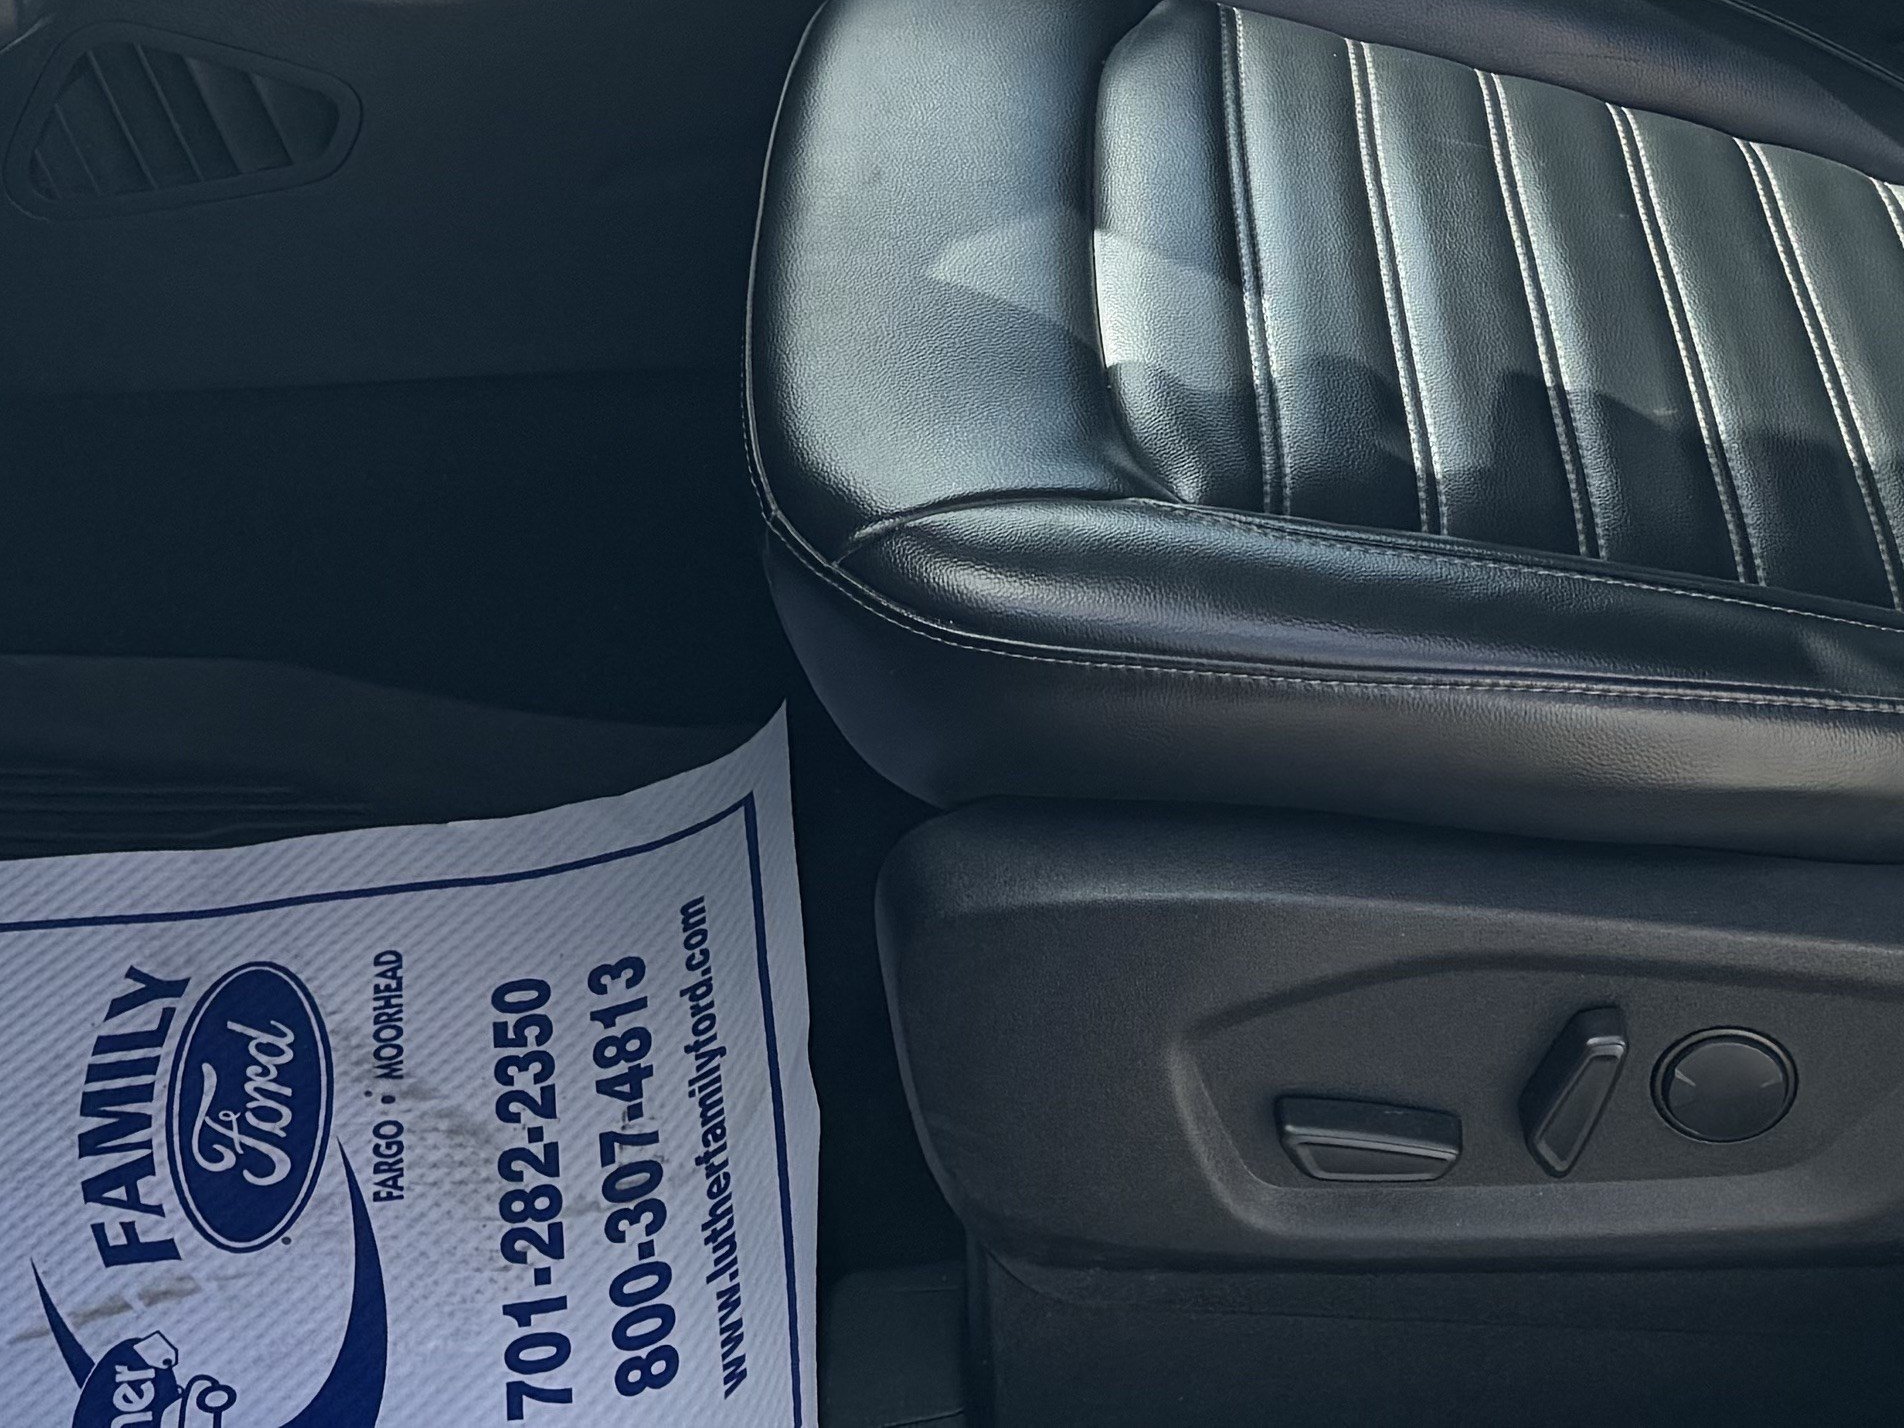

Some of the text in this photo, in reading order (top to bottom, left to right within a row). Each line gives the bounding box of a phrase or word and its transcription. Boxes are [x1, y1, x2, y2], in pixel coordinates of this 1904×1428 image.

[78, 965, 191, 1268] FAMILY
[191, 1020, 295, 1186] Ford
[373, 949, 404, 1202] FARGO MOORHEAD
[491, 978, 573, 1421] 701-282-2350
[587, 956, 679, 1397] 800-307-4813
[679, 895, 746, 1400] www.lutherfamilyford.com
